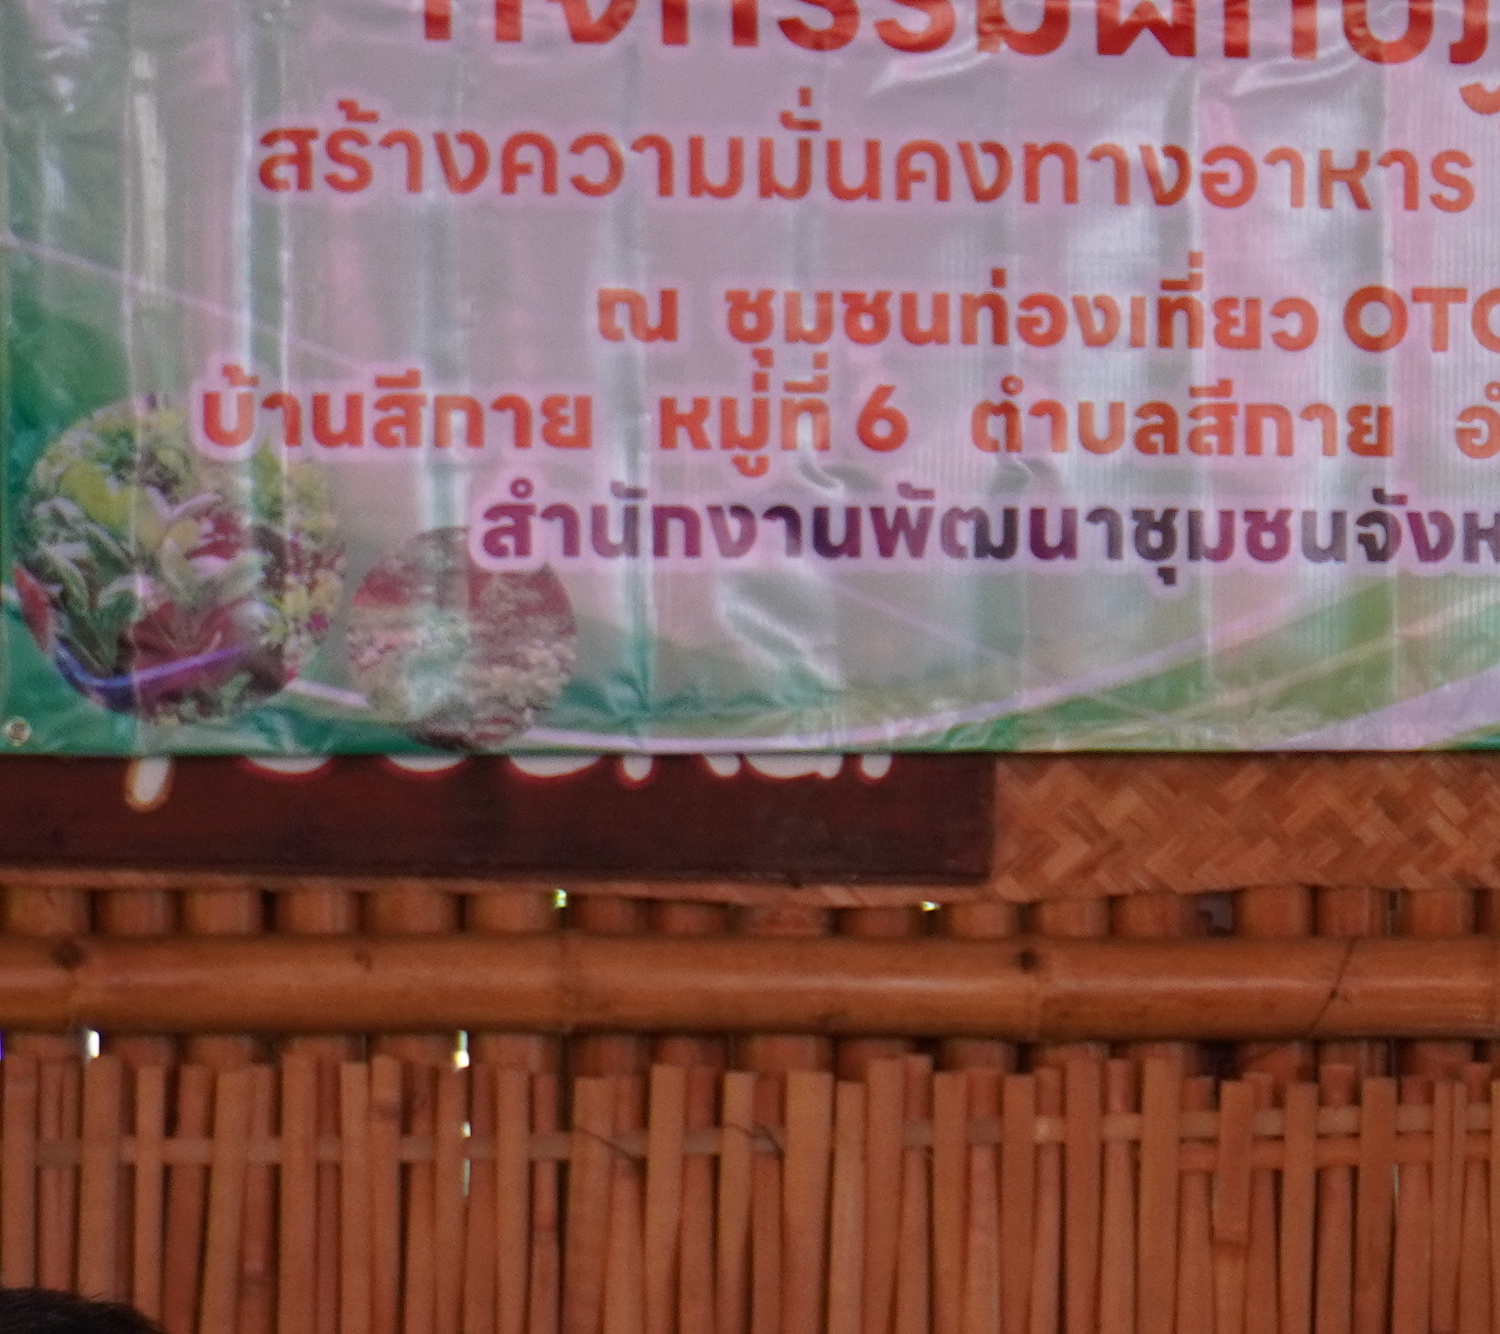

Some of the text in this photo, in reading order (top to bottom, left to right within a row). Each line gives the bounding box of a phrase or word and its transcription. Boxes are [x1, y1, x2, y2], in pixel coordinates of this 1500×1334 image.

[257, 87, 1474, 213] สร้างความมั่นคงทางอาหาร
[598, 285, 678, 344] ณ
[727, 253, 1318, 367] ชุมชนท่องเที่ยว
[203, 366, 592, 452] บ้านสีกาย
[659, 352, 831, 477] หมู่ที่
[856, 384, 909, 453] 6
[972, 376, 1392, 458] ตำบลสีกาย
